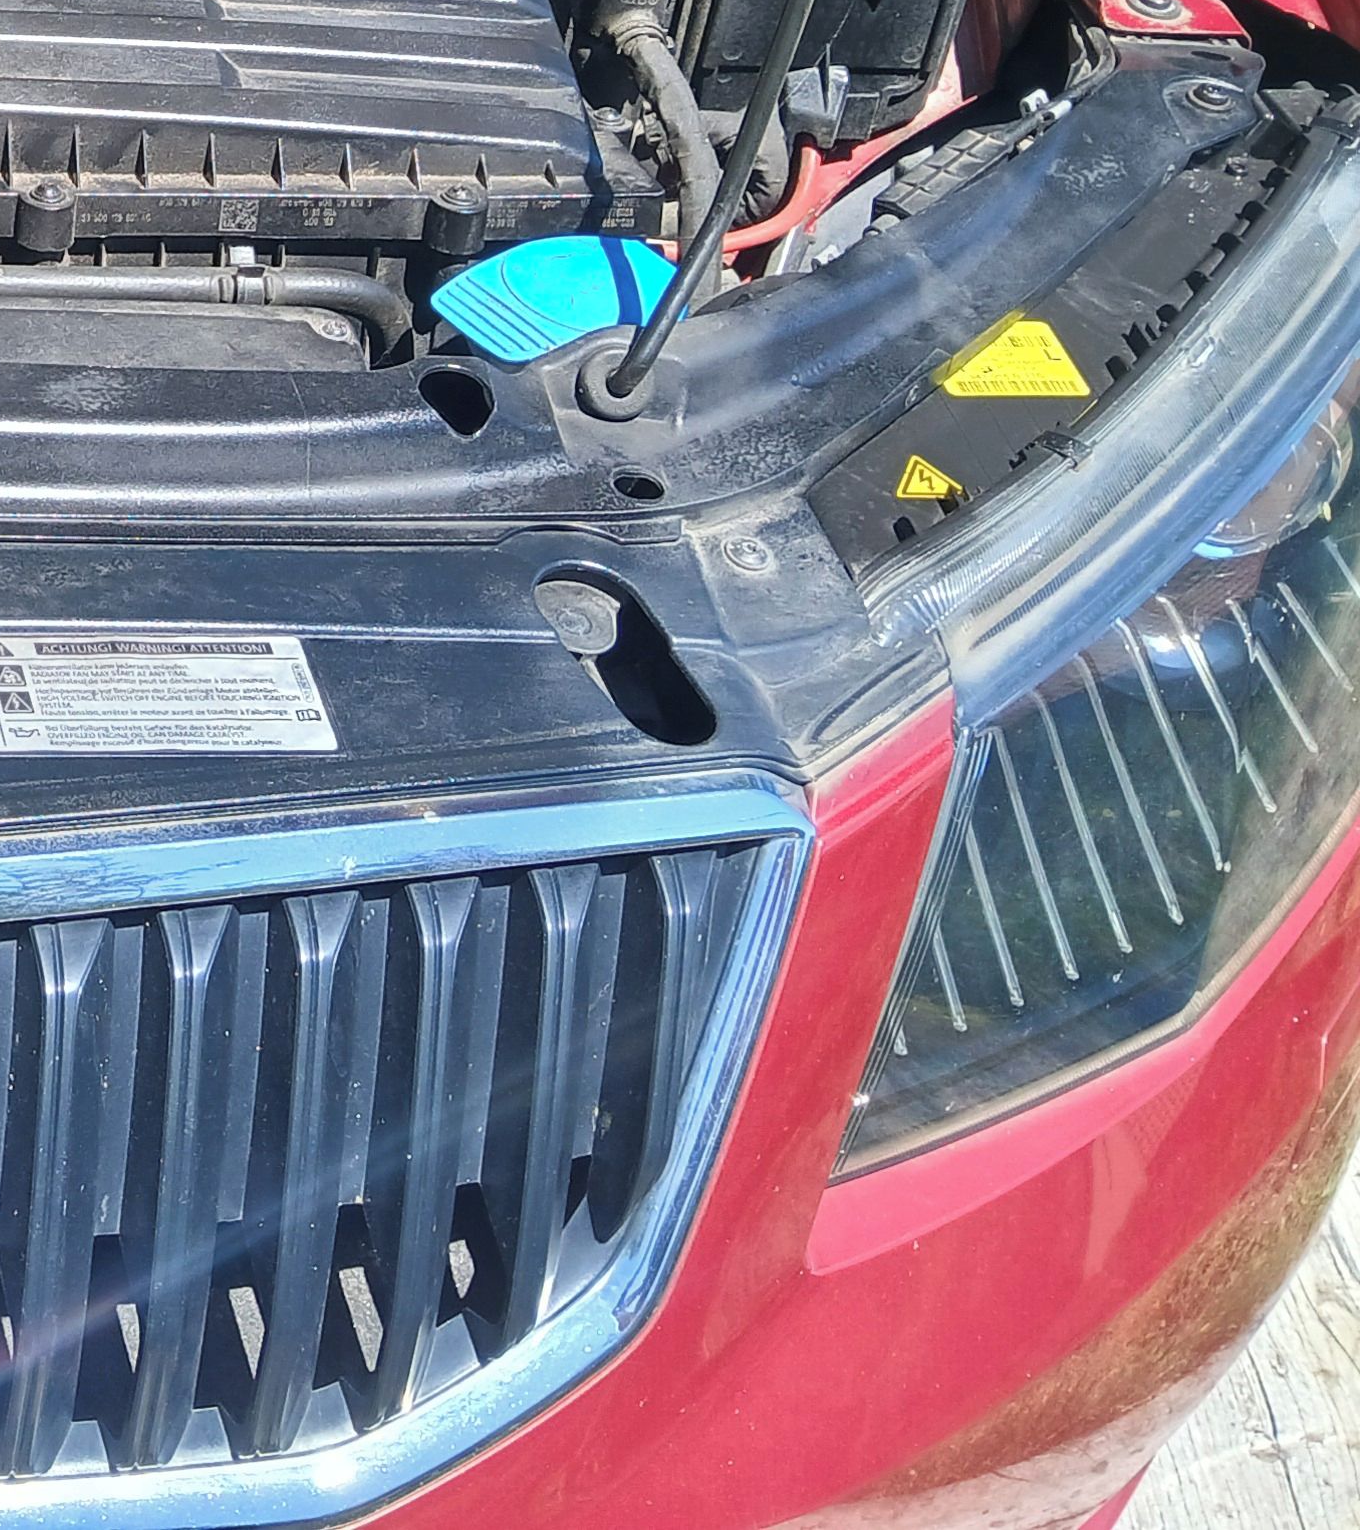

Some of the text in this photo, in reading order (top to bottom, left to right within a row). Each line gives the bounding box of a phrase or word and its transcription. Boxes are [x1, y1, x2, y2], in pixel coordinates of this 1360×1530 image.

[41, 643, 267, 654] ACHTUNG! WARNING! ATTENTION!
